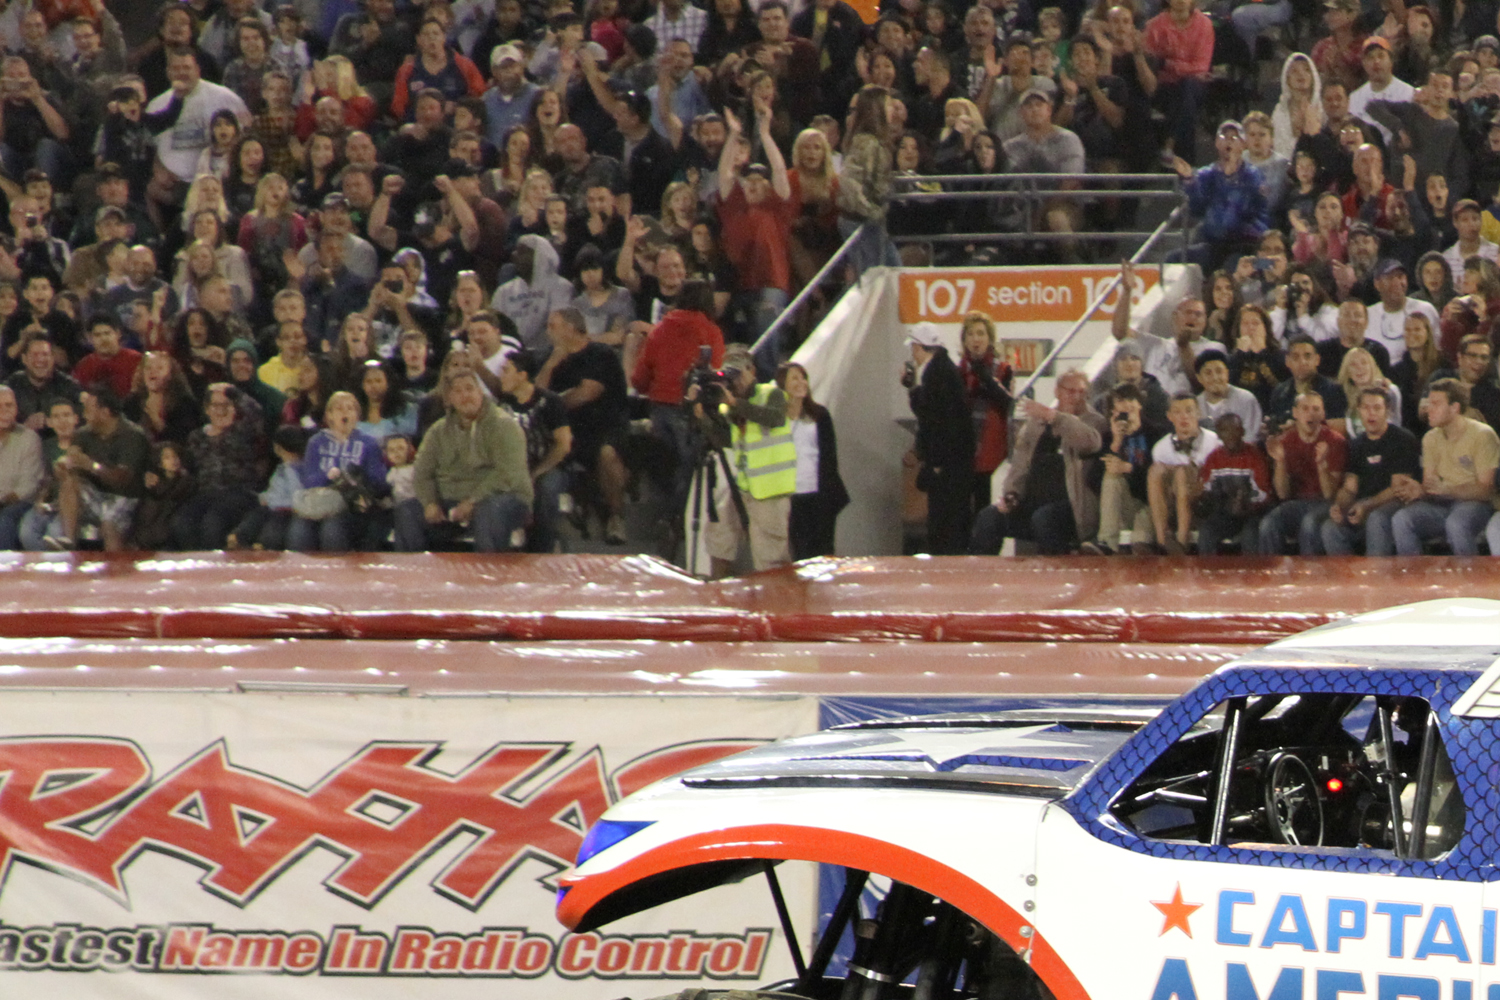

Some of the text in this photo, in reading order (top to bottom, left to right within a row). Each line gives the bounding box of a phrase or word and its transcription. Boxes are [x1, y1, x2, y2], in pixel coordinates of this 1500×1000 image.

[915, 279, 975, 316] 107
[988, 281, 1072, 306] section
[160, 926, 322, 972] Name
[325, 927, 388, 973] In
[391, 928, 553, 974] Radio
[557, 929, 770, 977] Control
